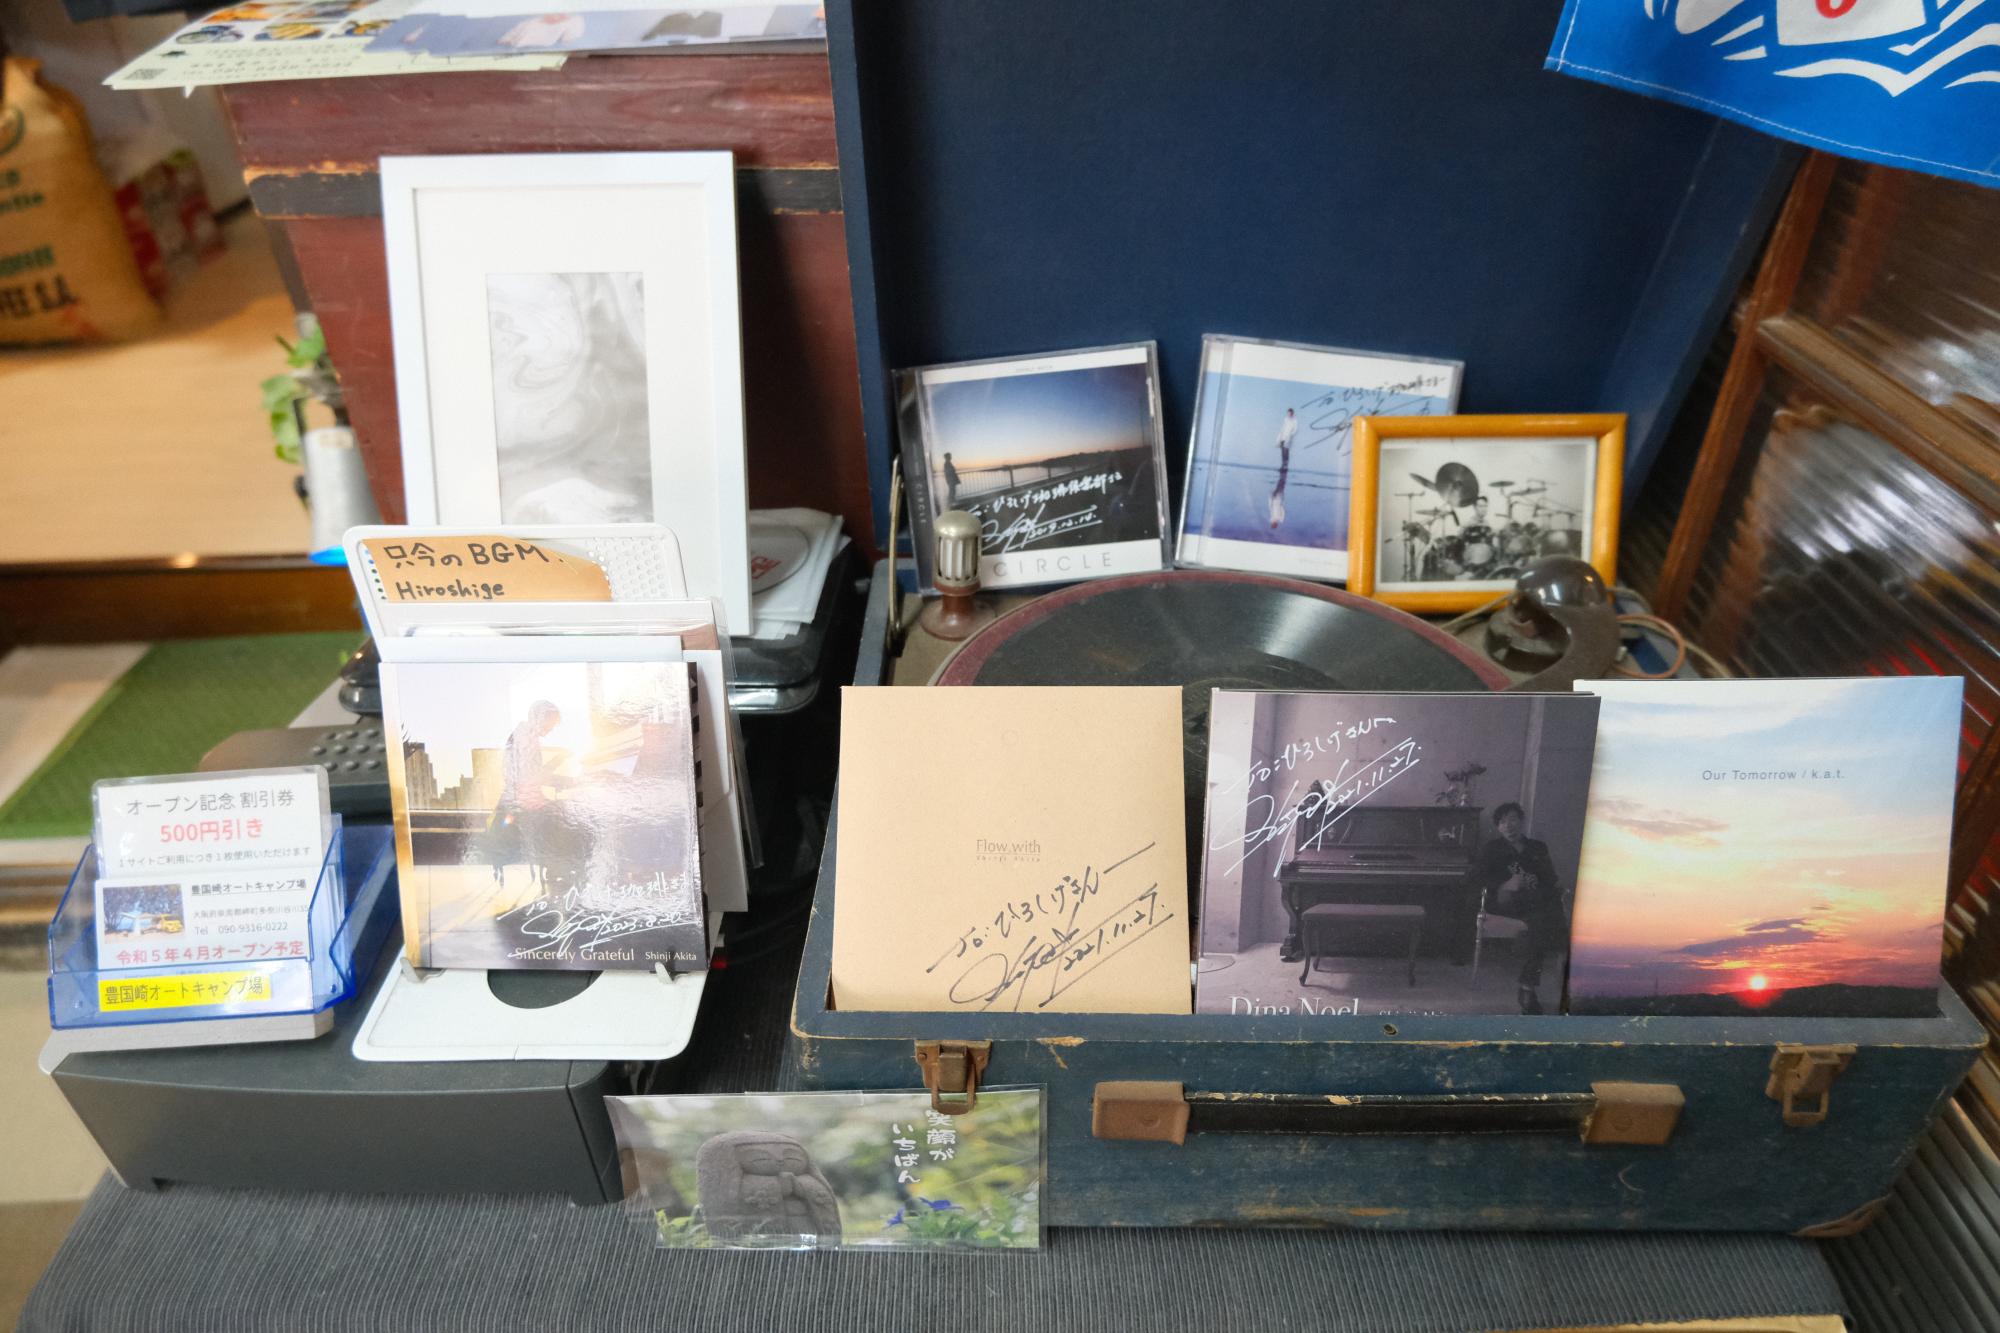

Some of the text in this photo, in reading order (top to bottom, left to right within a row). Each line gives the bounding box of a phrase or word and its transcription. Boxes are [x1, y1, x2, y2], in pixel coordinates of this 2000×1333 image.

[993, 551, 1113, 577] CIRCLE
[395, 579, 505, 600] Hiroshige
[1702, 769, 1727, 781] Our
[1732, 769, 1798, 781] Tomorrow
[1811, 768, 1846, 780] k.a.t.
[127, 789, 295, 816] オープン記念 割引券
[160, 818, 263, 844] 500円引き
[976, 838, 1041, 853] Flow with
[194, 926, 209, 936] Tel
[515, 947, 697, 963] Sincerely Grateful Shinji Akita
[104, 975, 264, 1005] 豊国崎オートキャンプ場
[892, 1123, 921, 1183] いちばん
